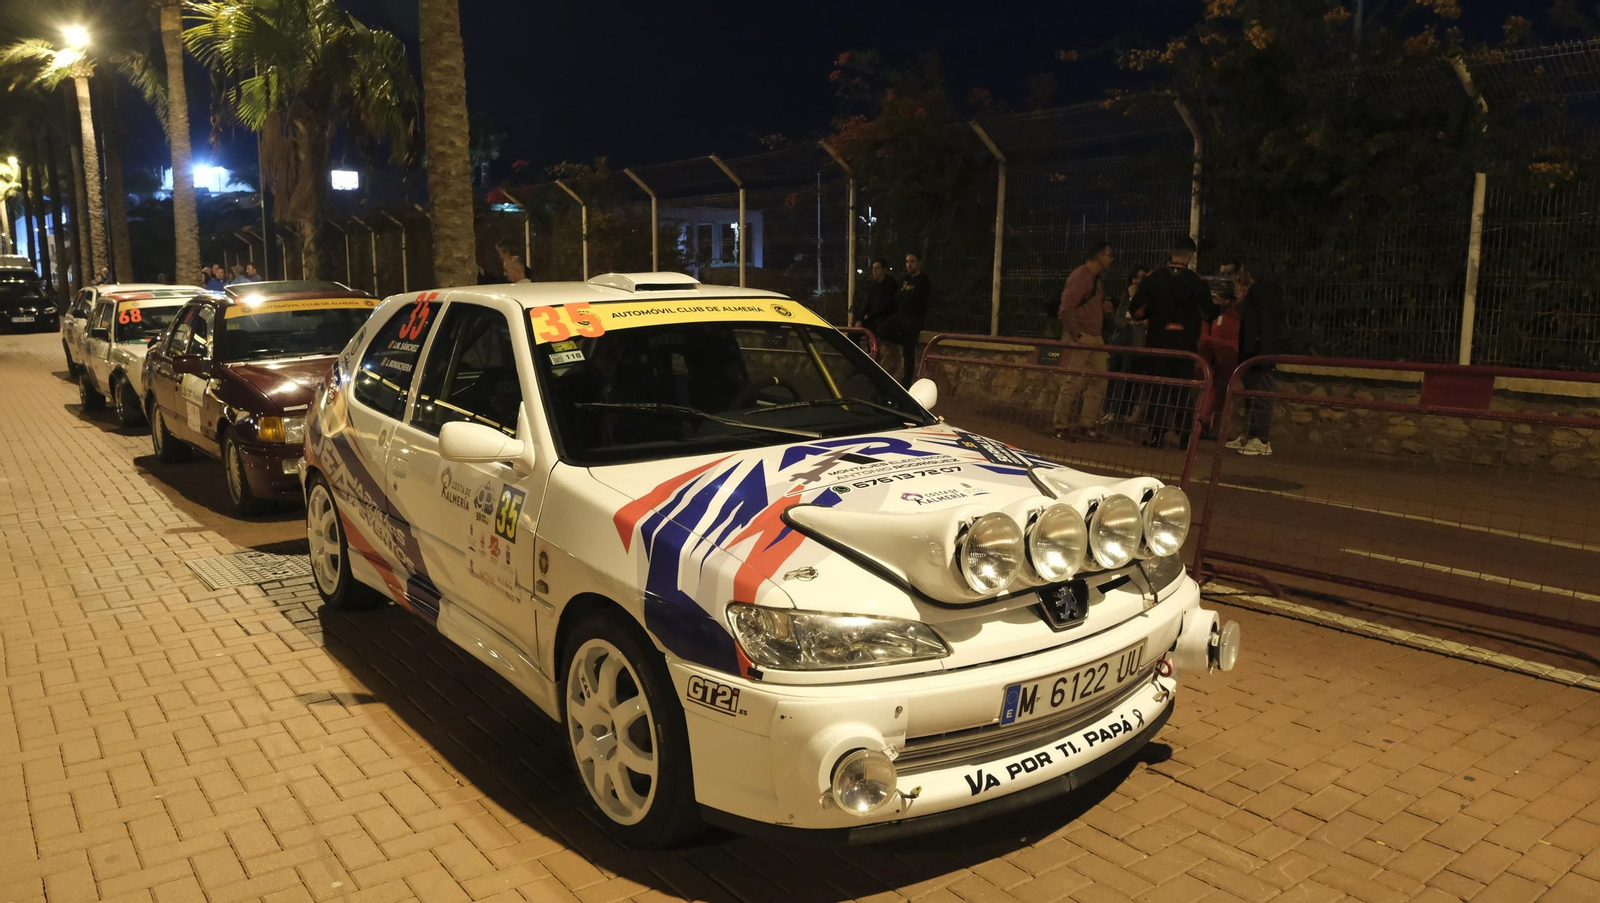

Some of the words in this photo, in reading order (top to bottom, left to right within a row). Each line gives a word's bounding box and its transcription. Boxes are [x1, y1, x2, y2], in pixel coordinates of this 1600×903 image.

[119, 308, 142, 324] 68
[399, 292, 439, 340] 35
[530, 302, 605, 342] 35
[611, 307, 676, 319] AUTOMÓVIL
[722, 305, 765, 313] ALMERÍA
[828, 463, 888, 476] MONTAJES
[837, 466, 892, 480] ANTONIO
[852, 477, 894, 489] 676
[913, 469, 941, 477] 72
[497, 490, 523, 538] 35
[1018, 684, 1038, 718] M
[1050, 662, 1109, 708] 6122
[1117, 646, 1143, 683] UU
[1006, 709, 1013, 718] E
[1006, 751, 1053, 780] POR
[1055, 741, 1081, 758] TI,
[1083, 714, 1133, 747] PAPÁ
